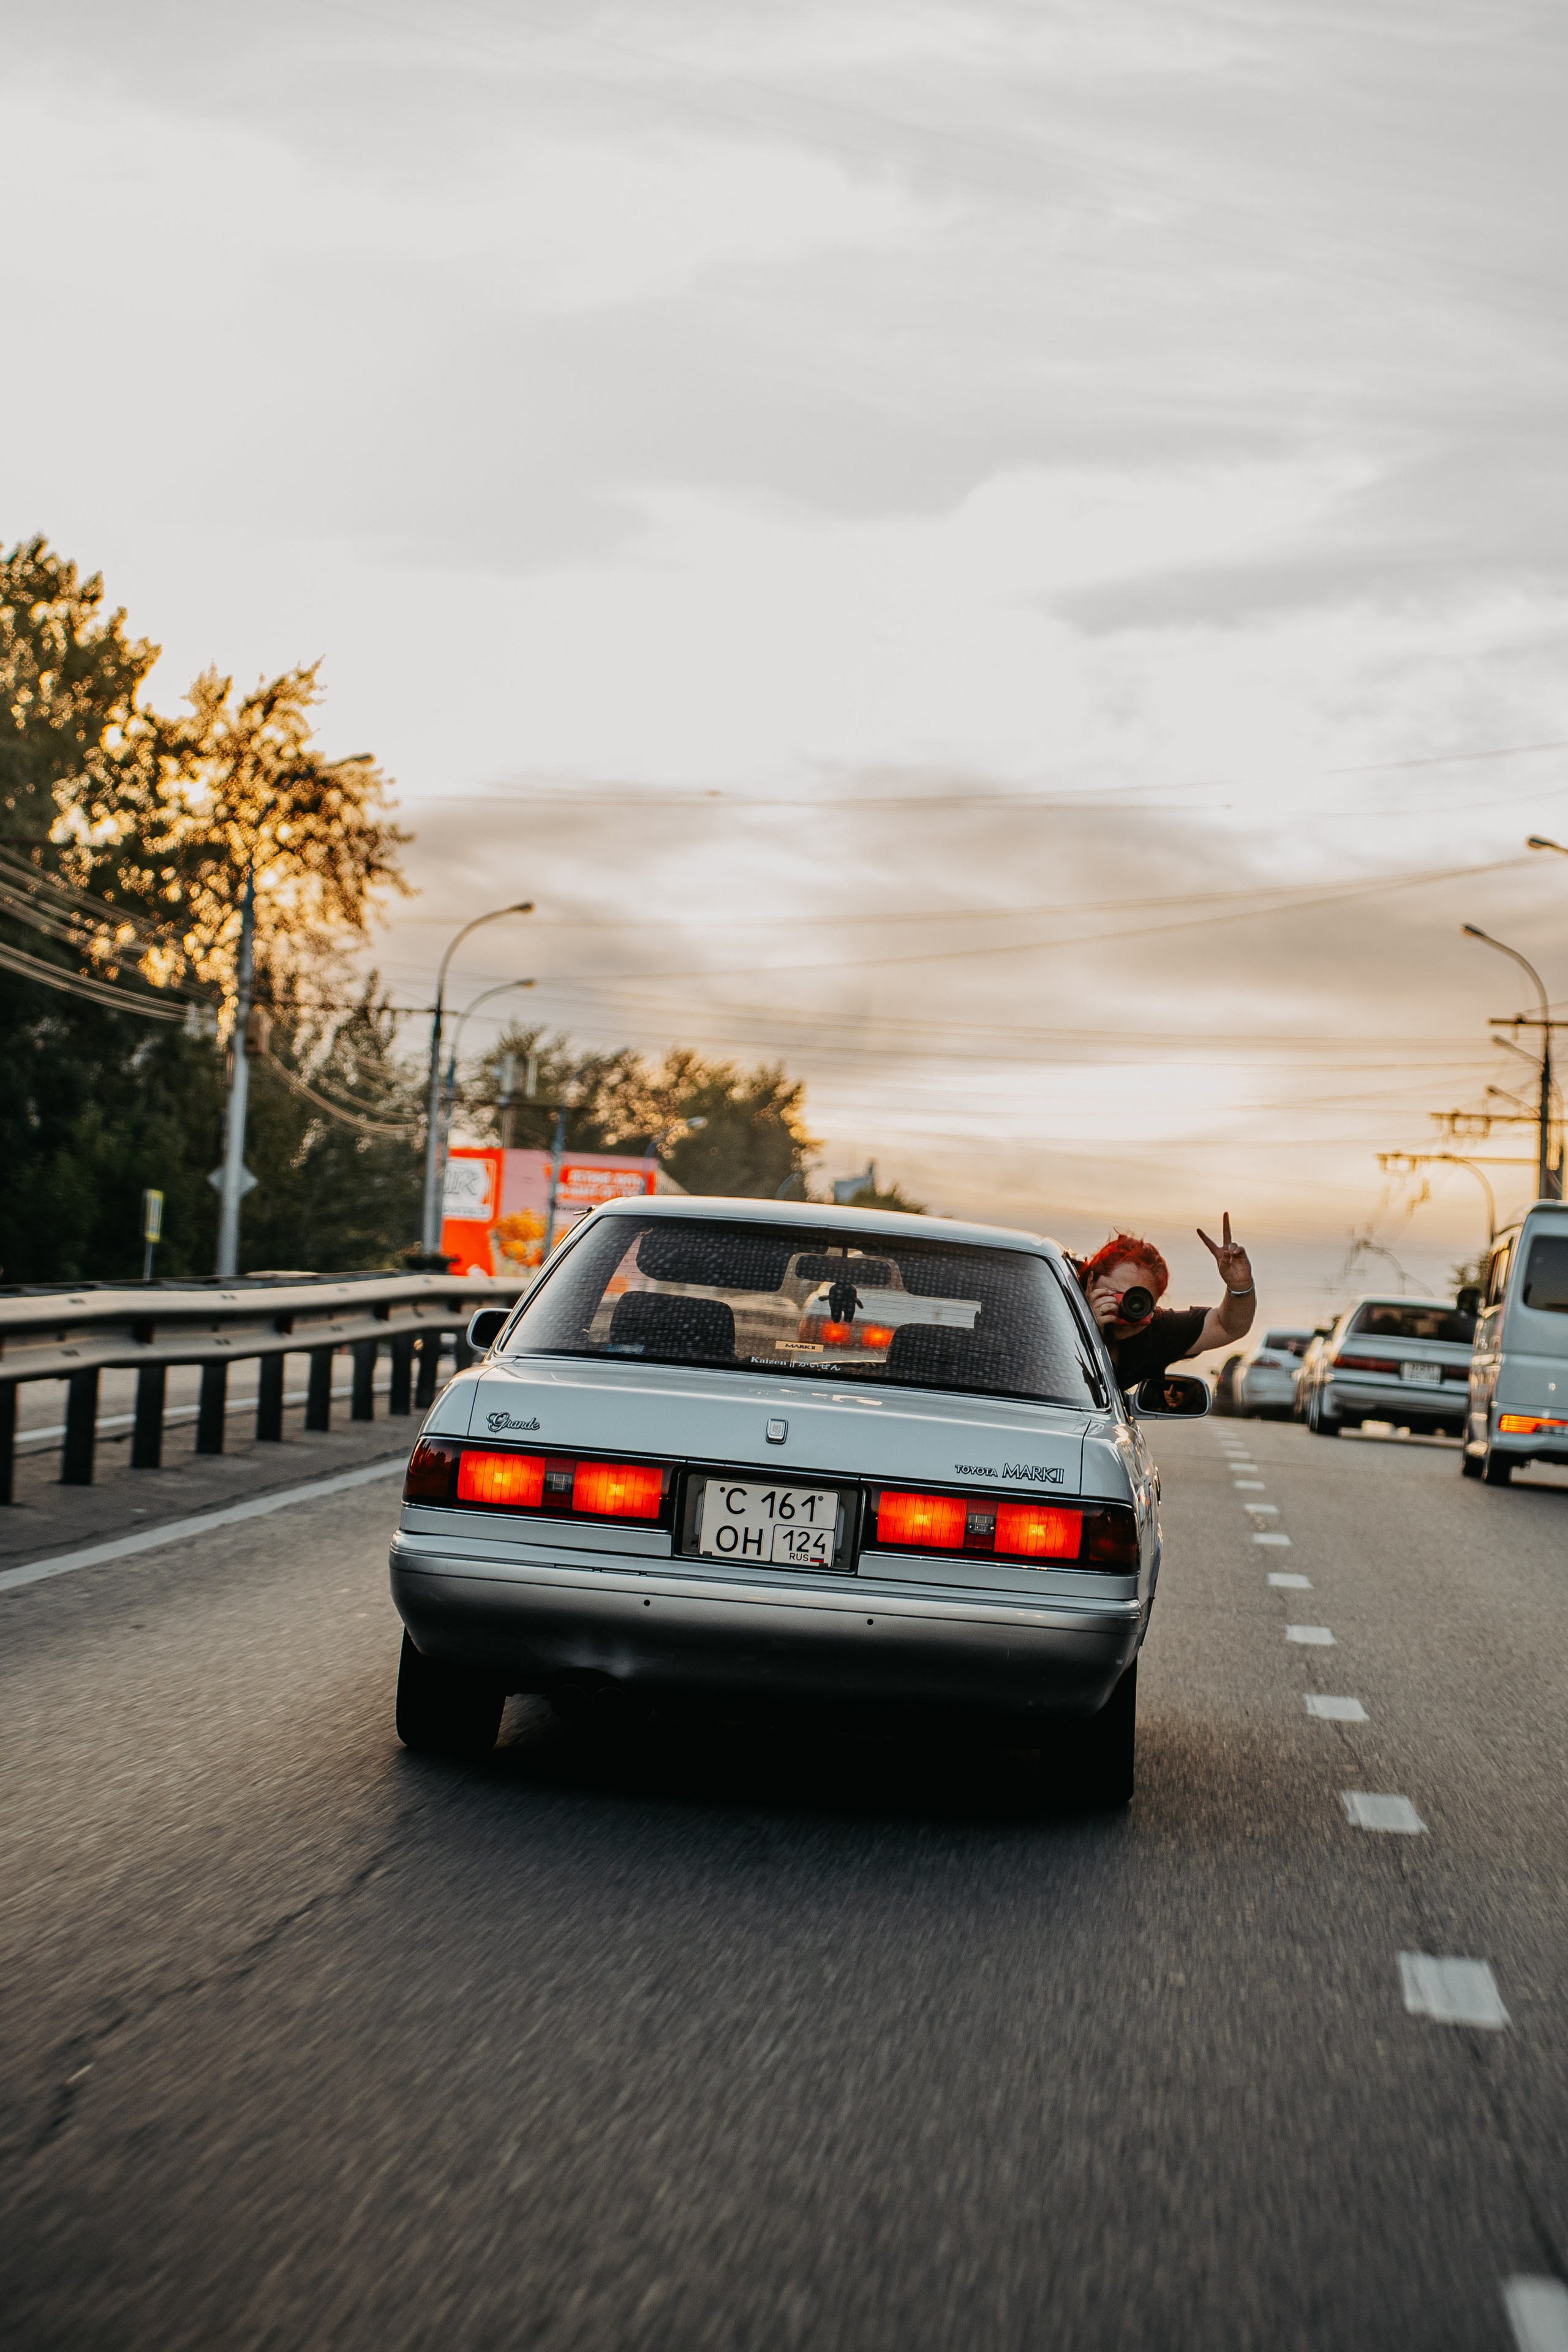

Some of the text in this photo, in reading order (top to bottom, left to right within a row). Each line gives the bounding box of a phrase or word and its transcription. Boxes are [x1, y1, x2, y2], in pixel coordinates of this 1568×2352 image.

[750, 1356, 786, 1365] Kaizen
[486, 1412, 540, 1432] Grande
[955, 1464, 998, 1477] TOYOTA
[761, 1491, 816, 1522] 161
[783, 1530, 826, 1554] 124
[789, 1553, 809, 1561] RUS
